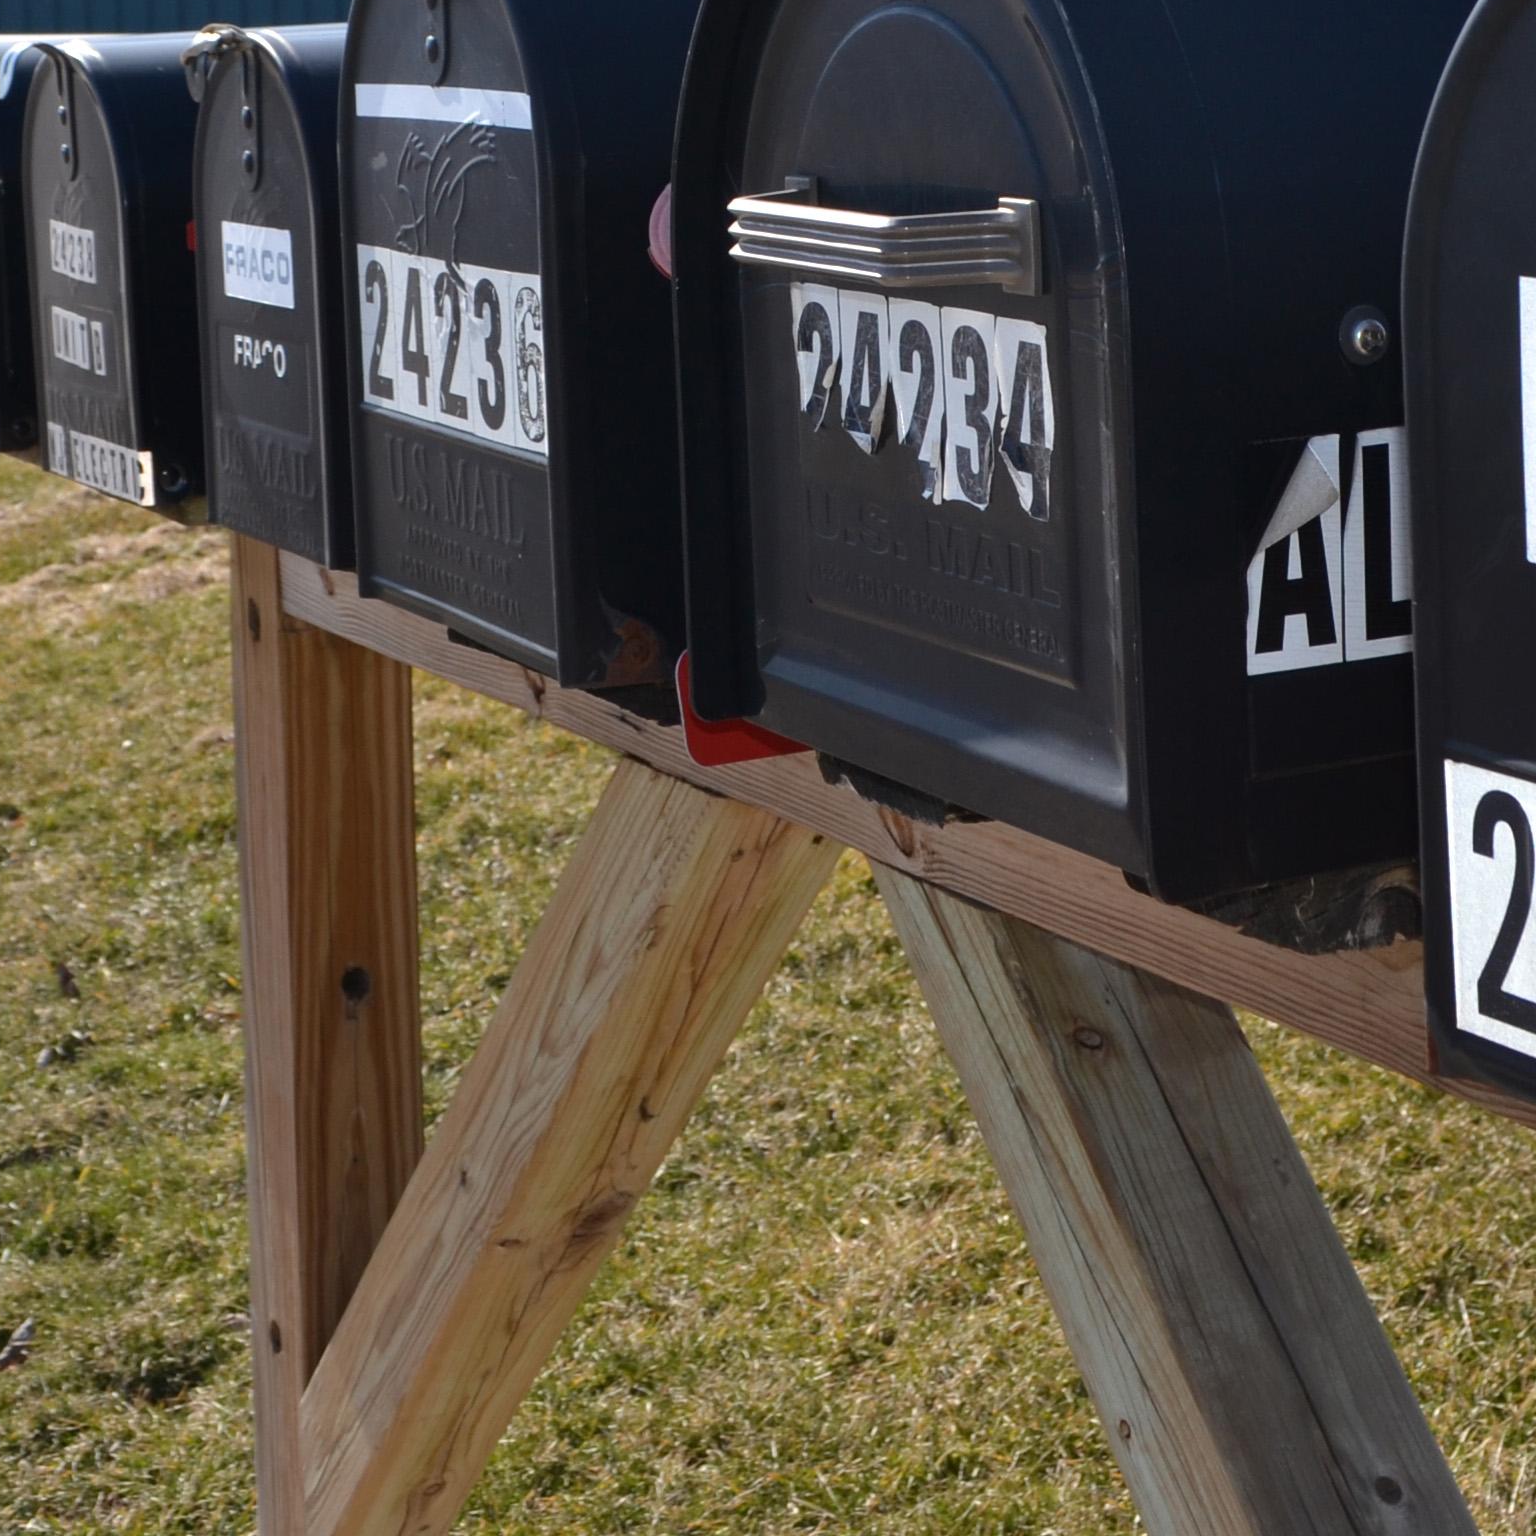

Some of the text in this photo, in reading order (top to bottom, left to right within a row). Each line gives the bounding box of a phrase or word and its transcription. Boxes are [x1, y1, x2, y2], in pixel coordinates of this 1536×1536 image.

[52, 228, 94, 279] 24238
[224, 242, 291, 286] FRACO
[365, 259, 546, 444] 24236
[797, 301, 1051, 521] 24234
[73, 437, 146, 502] ELECTRIC
[384, 430, 525, 546] U.S. MAIL
[924, 519, 1063, 610] MAIL
